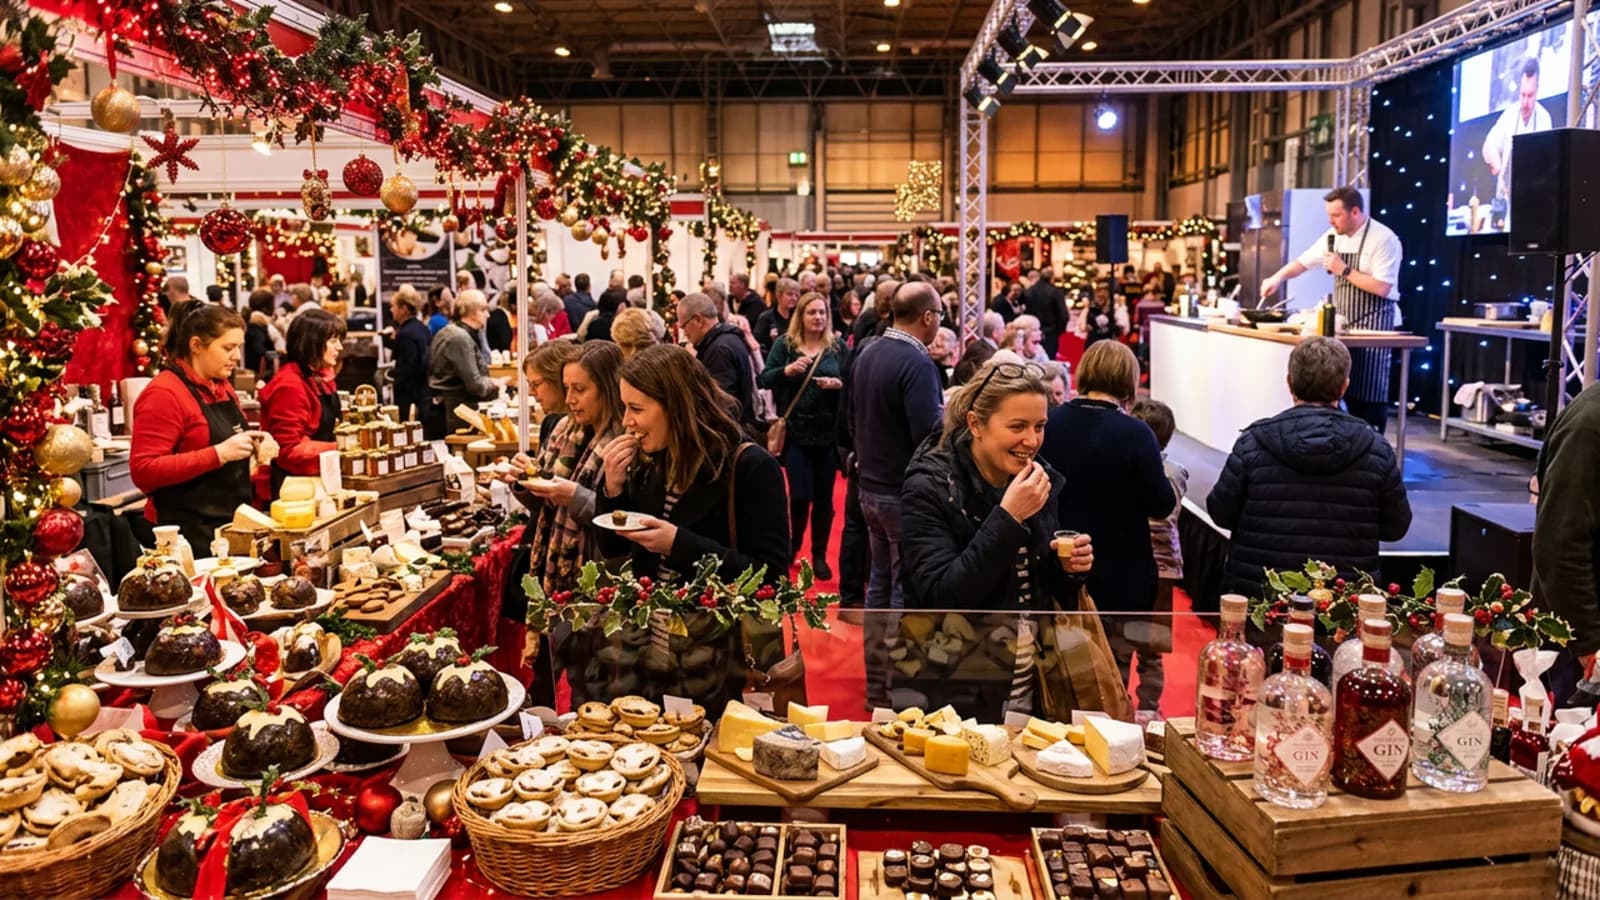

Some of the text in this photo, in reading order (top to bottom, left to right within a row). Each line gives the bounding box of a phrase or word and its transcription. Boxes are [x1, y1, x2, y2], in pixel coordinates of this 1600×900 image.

[1457, 737, 1482, 746] GIN
[1374, 744, 1404, 756] GIN
[1293, 751, 1319, 760] GIN
